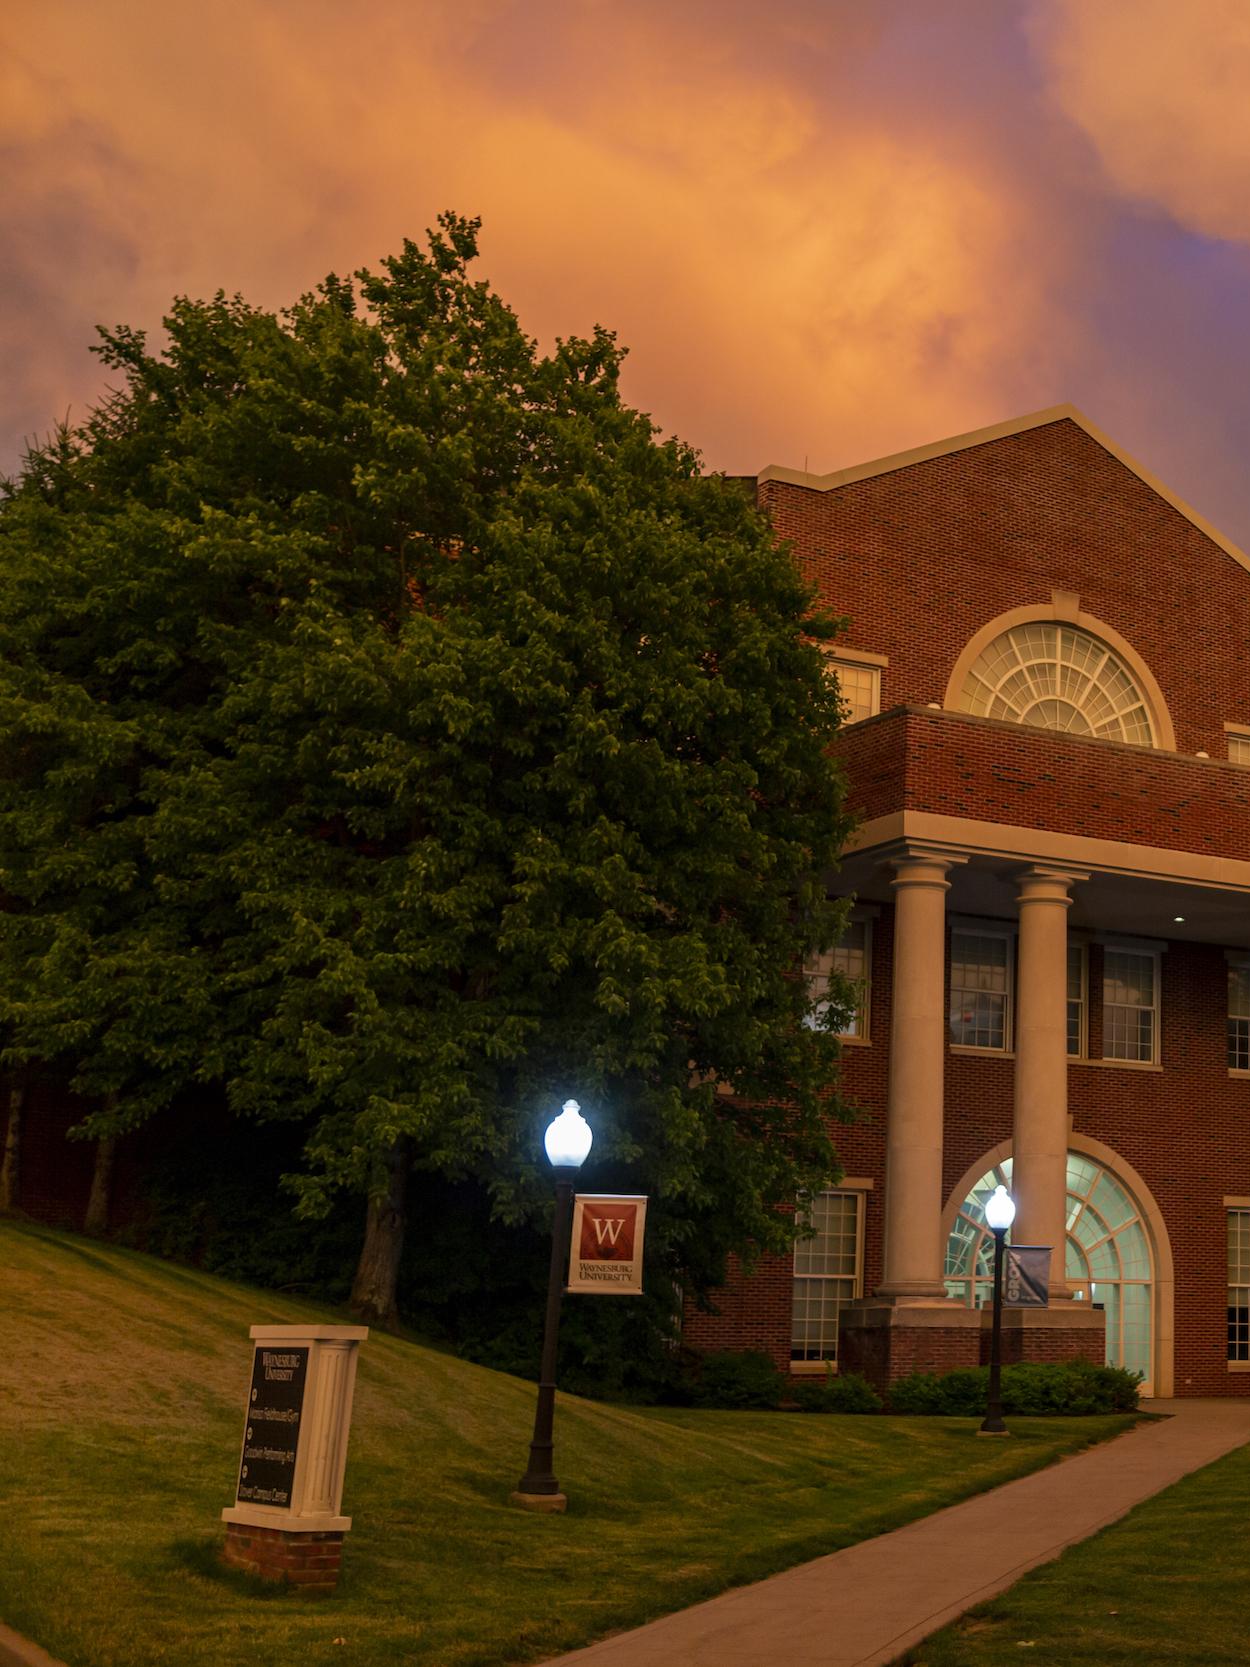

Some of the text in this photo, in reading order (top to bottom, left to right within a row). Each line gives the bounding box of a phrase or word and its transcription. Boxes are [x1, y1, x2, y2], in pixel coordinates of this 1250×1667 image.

[592, 1218, 625, 1245] W
[580, 1263, 632, 1273] WAYNESBURG
[579, 1271, 632, 1281] UNIVERSITY
